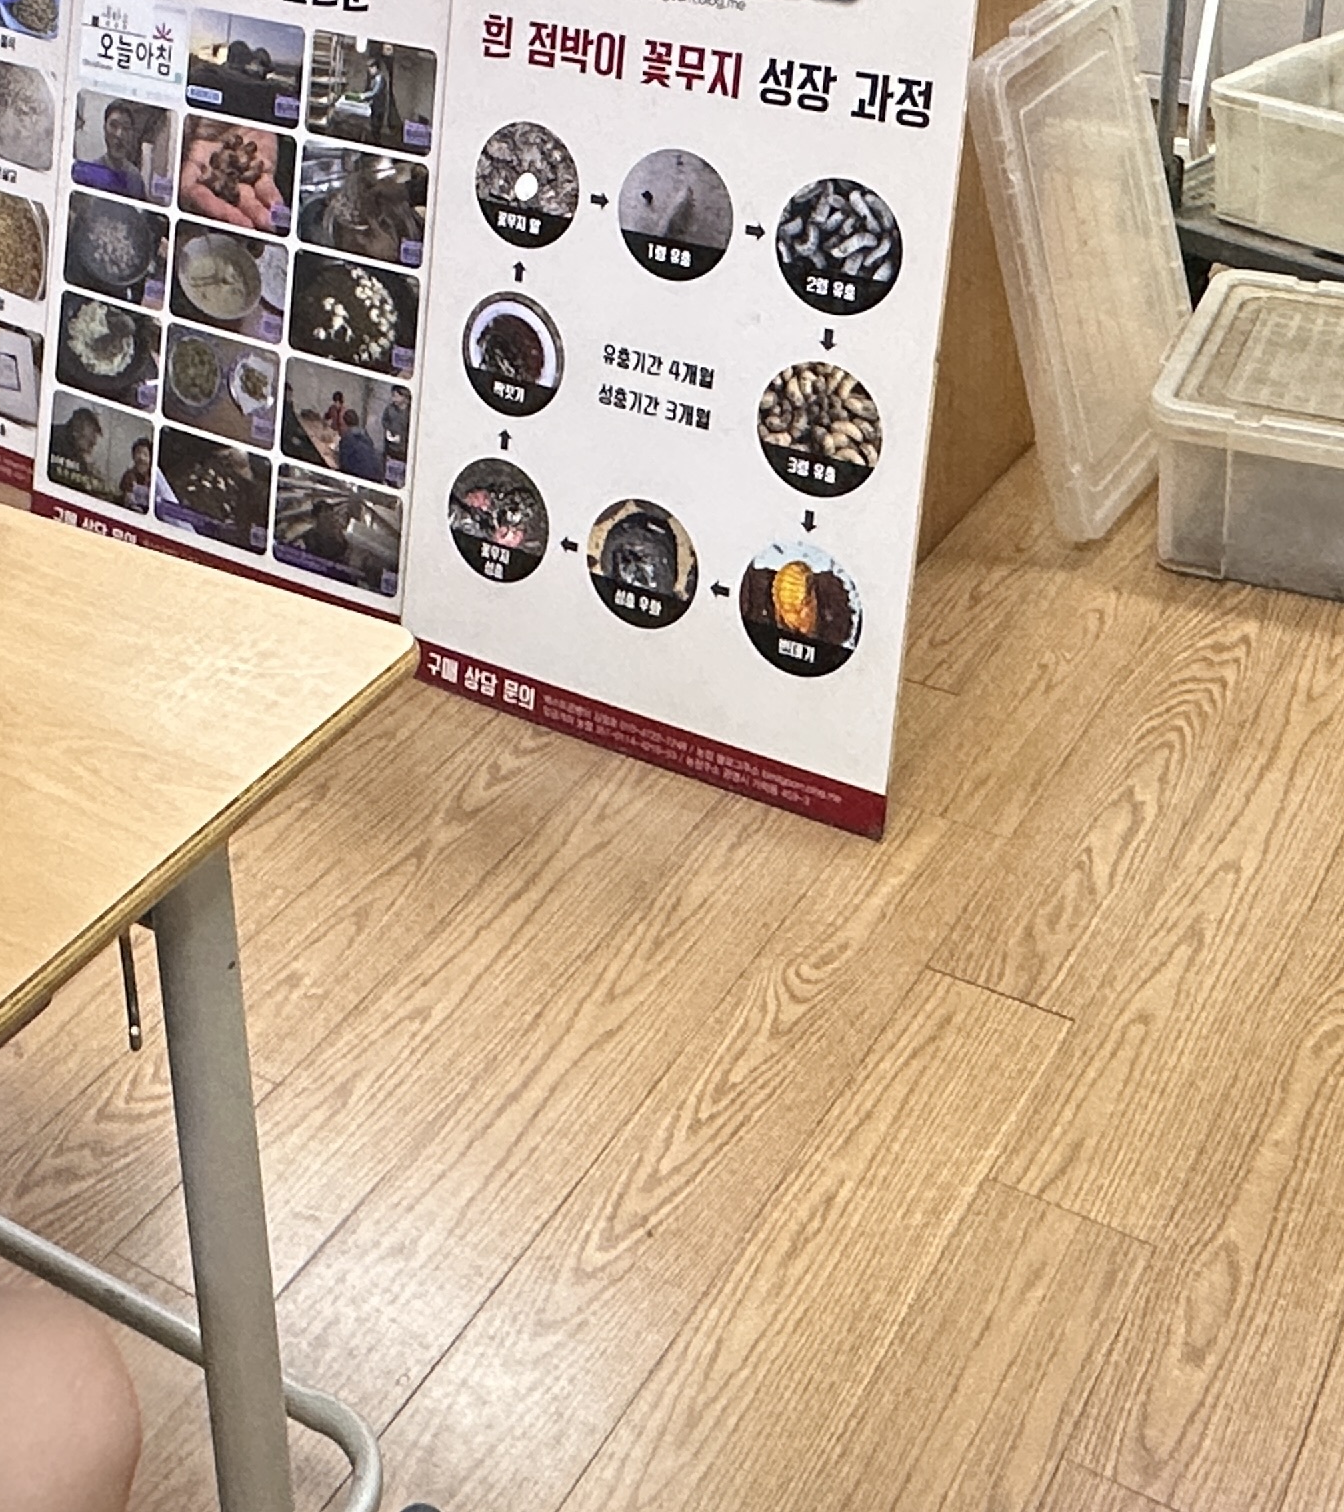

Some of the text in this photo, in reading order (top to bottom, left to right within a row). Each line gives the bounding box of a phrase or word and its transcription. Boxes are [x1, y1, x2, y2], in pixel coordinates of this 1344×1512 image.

[97, 33, 172, 76] 오늘아침
[482, 14, 934, 130] 흰 점박이 꽃무지 성장 과정
[602, 344, 715, 391] 유충기간 4개월
[598, 384, 711, 432] 성충기간 3개월
[778, 638, 816, 664] 번데기
[426, 652, 536, 712] 구매 상담 문의
